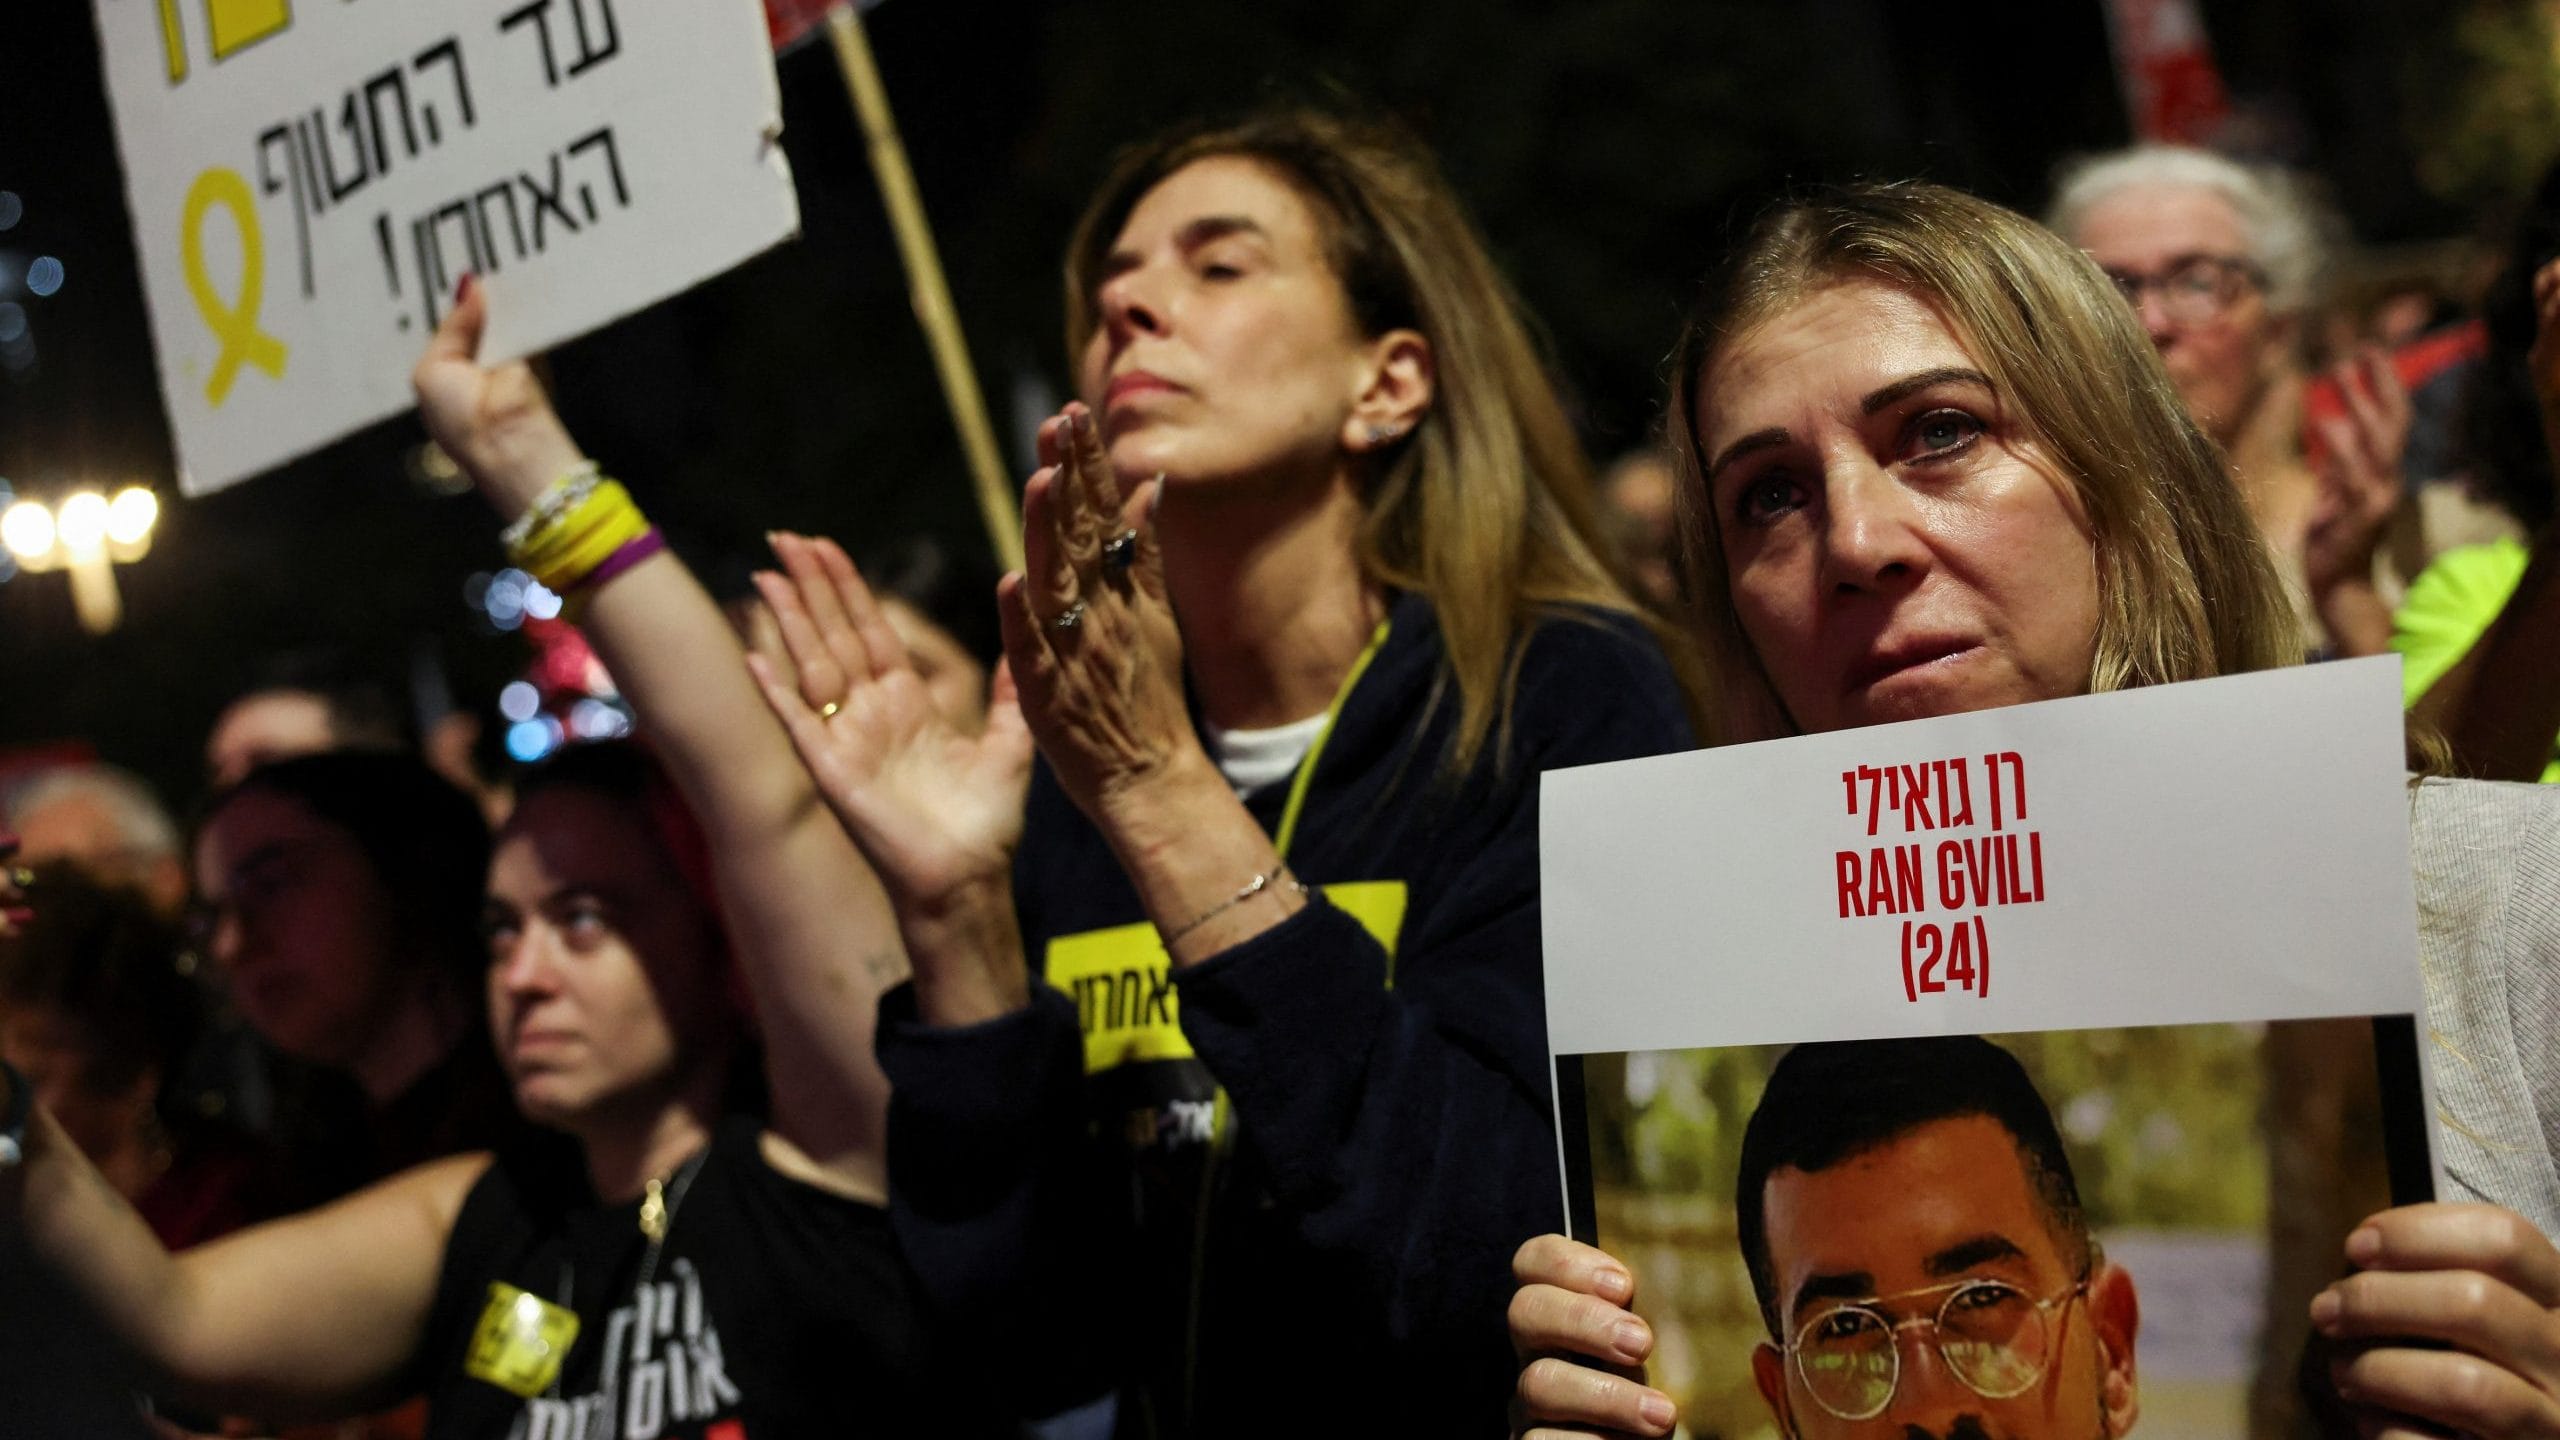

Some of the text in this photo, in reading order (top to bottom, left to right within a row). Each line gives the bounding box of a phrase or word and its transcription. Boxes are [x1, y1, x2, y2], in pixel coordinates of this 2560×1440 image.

[497, 0, 622, 88] עד
[256, 36, 477, 298] החטוף
[374, 126, 631, 337] האחרון!
[1841, 751, 2027, 837] רן גואילי
[1835, 831, 2045, 919] RAN GVILI
[1900, 914, 1990, 1003] (24)
